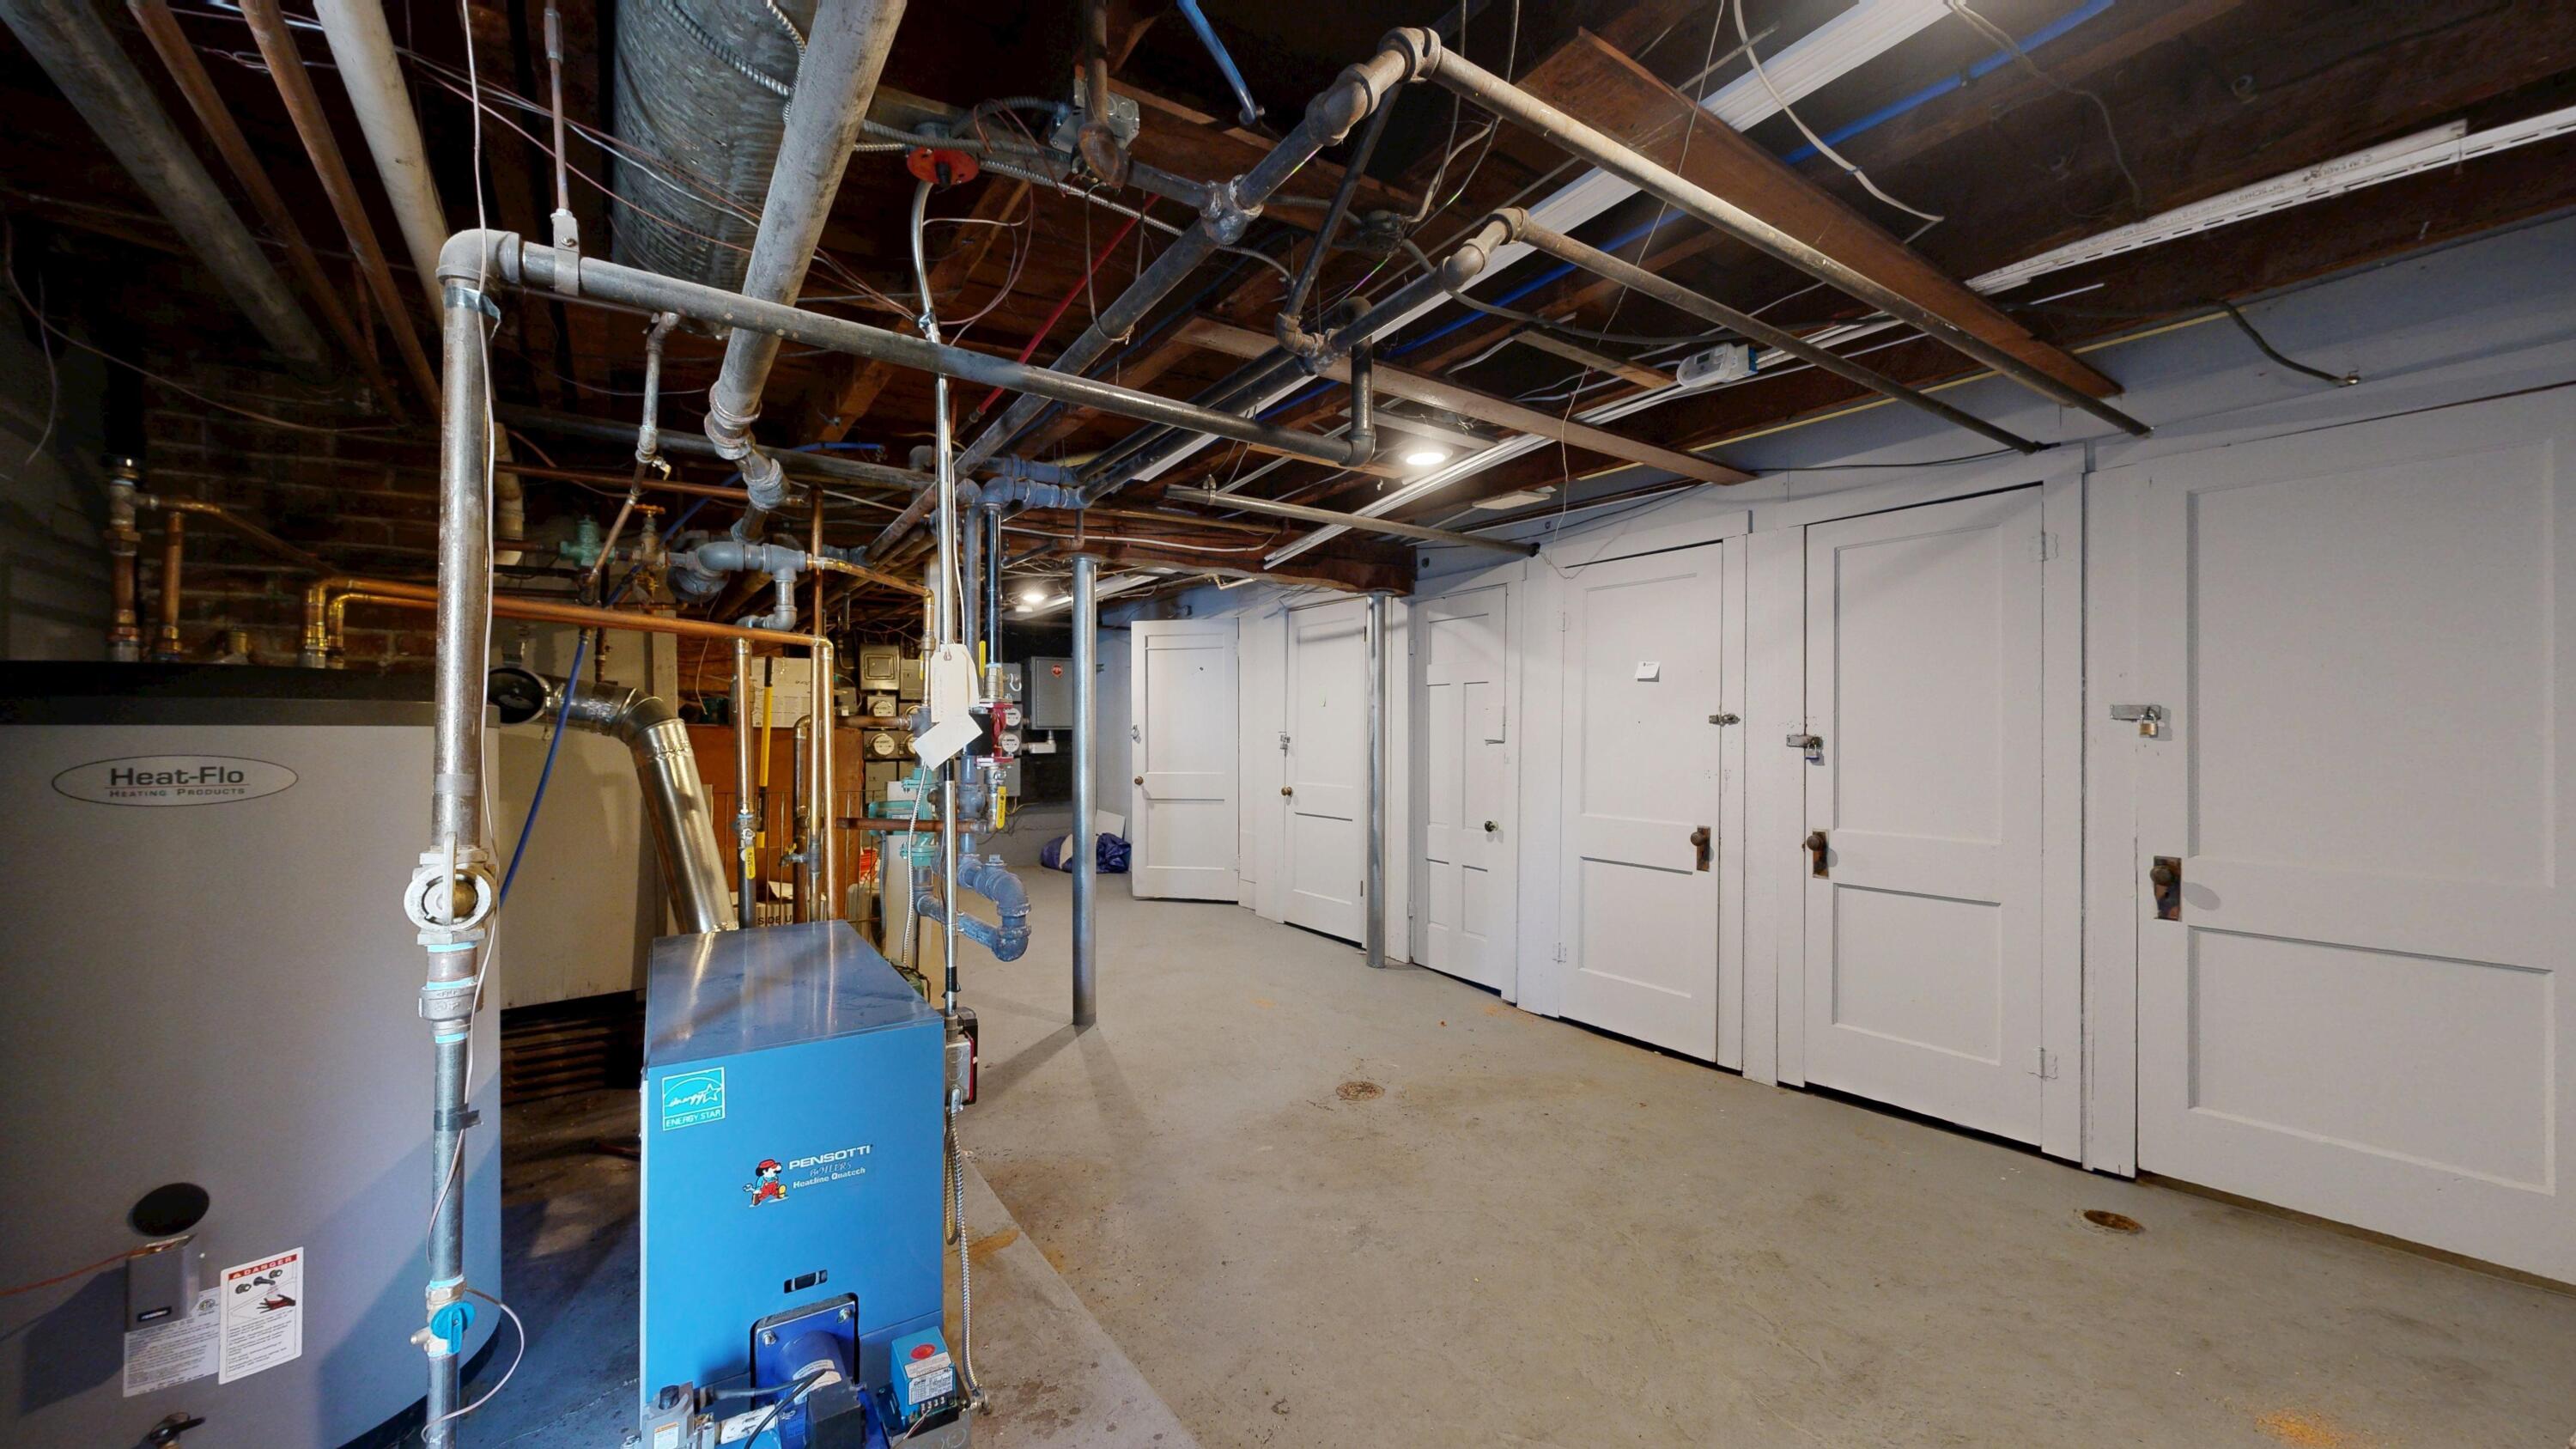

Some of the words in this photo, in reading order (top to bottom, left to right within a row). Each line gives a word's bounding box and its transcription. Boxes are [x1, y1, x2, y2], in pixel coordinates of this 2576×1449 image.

[111, 766, 245, 786] Heat-Flo
[177, 788, 246, 796] PRODUCTS
[757, 915, 781, 925] SDE
[665, 1113, 700, 1128] ENERGY
[700, 1109, 721, 1120] STAR
[788, 1145, 871, 1170] PENSOTTI
[244, 1257, 292, 1275] DANGER
